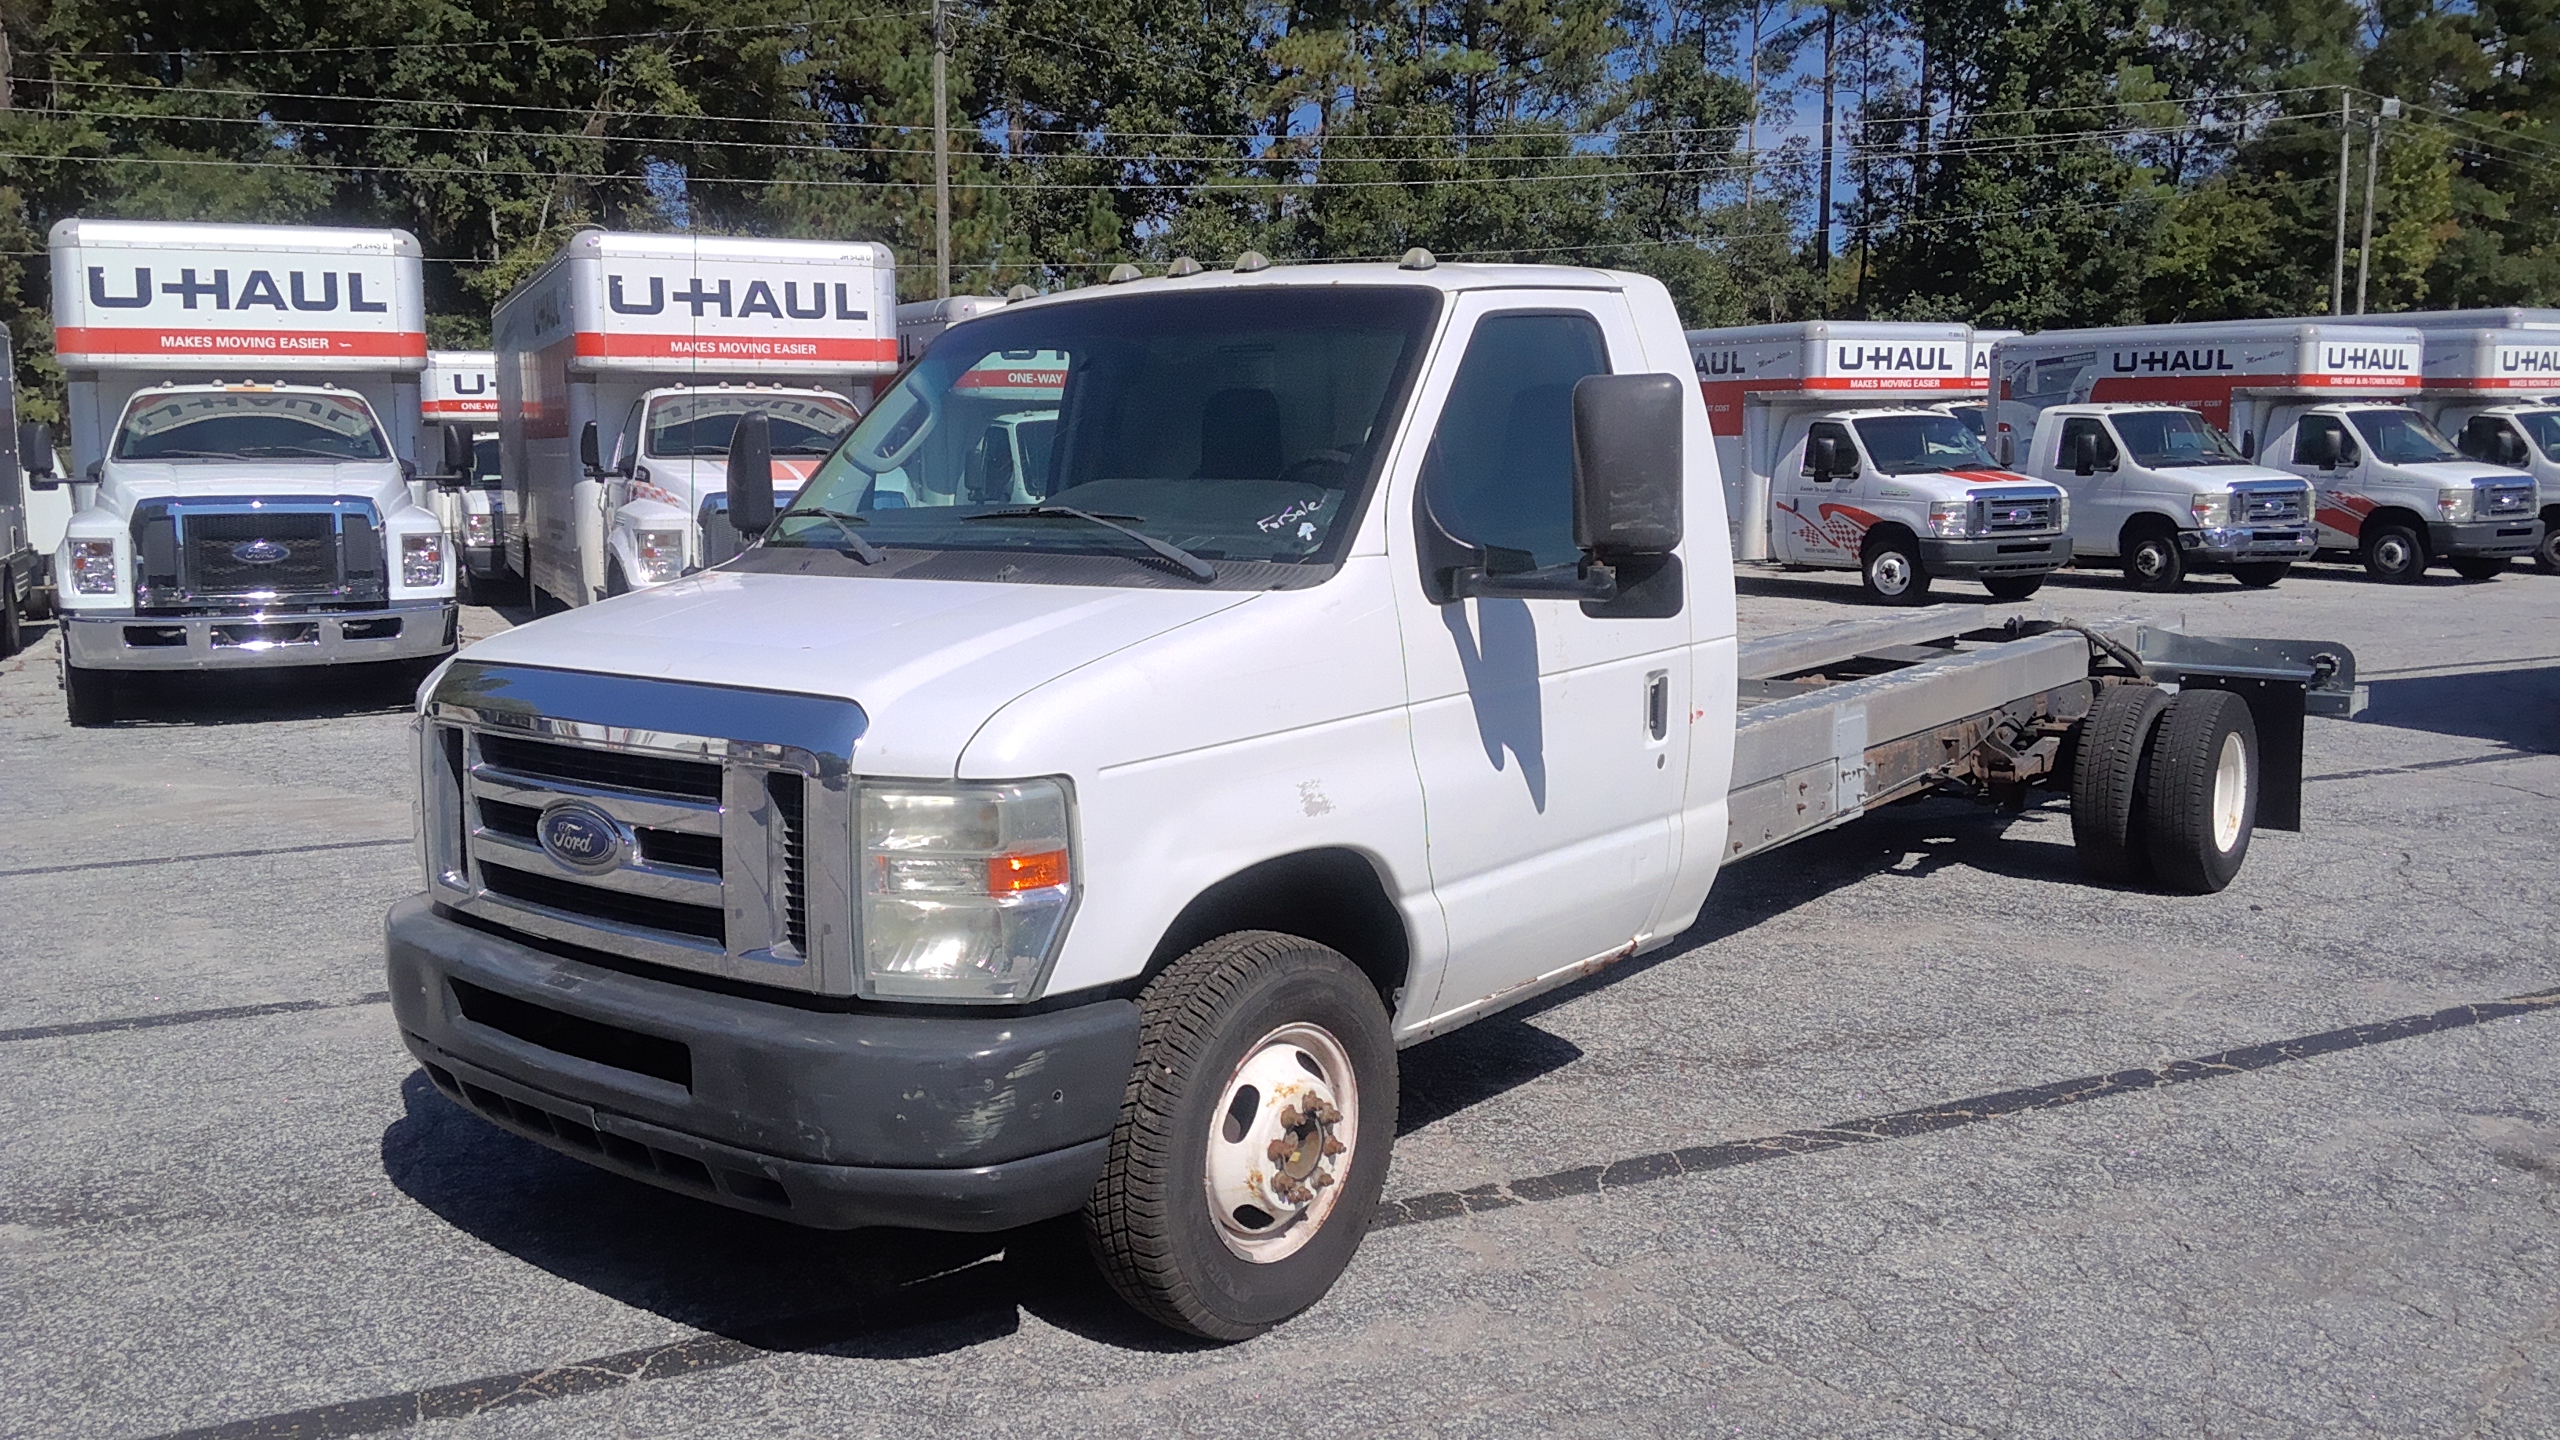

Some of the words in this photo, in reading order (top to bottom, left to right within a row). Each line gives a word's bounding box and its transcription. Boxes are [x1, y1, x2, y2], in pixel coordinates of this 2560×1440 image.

[88, 266, 388, 313] U-HAUL
[608, 274, 868, 321] U-HAUL
[160, 335, 213, 348] MAKES
[216, 336, 276, 349] MOVING
[280, 337, 329, 350] EASIER
[670, 341, 716, 353] MAKES
[718, 342, 772, 354] MOVING
[774, 343, 817, 355] EASIER
[1694, 351, 1746, 375] AUL
[1839, 346, 1953, 371] U-HAUL
[2113, 349, 2234, 373] U-HAUL
[2328, 347, 2409, 370] U-HAUL
[2503, 350, 2560, 371] U-HA
[1007, 373, 1063, 384] ONE-WAY
[1850, 379, 1878, 388] MAKES
[1880, 379, 1912, 388] MOVING
[1913, 379, 1940, 388] EASIER
[461, 402, 498, 410] ONE-W
[553, 821, 593, 853] Ford
